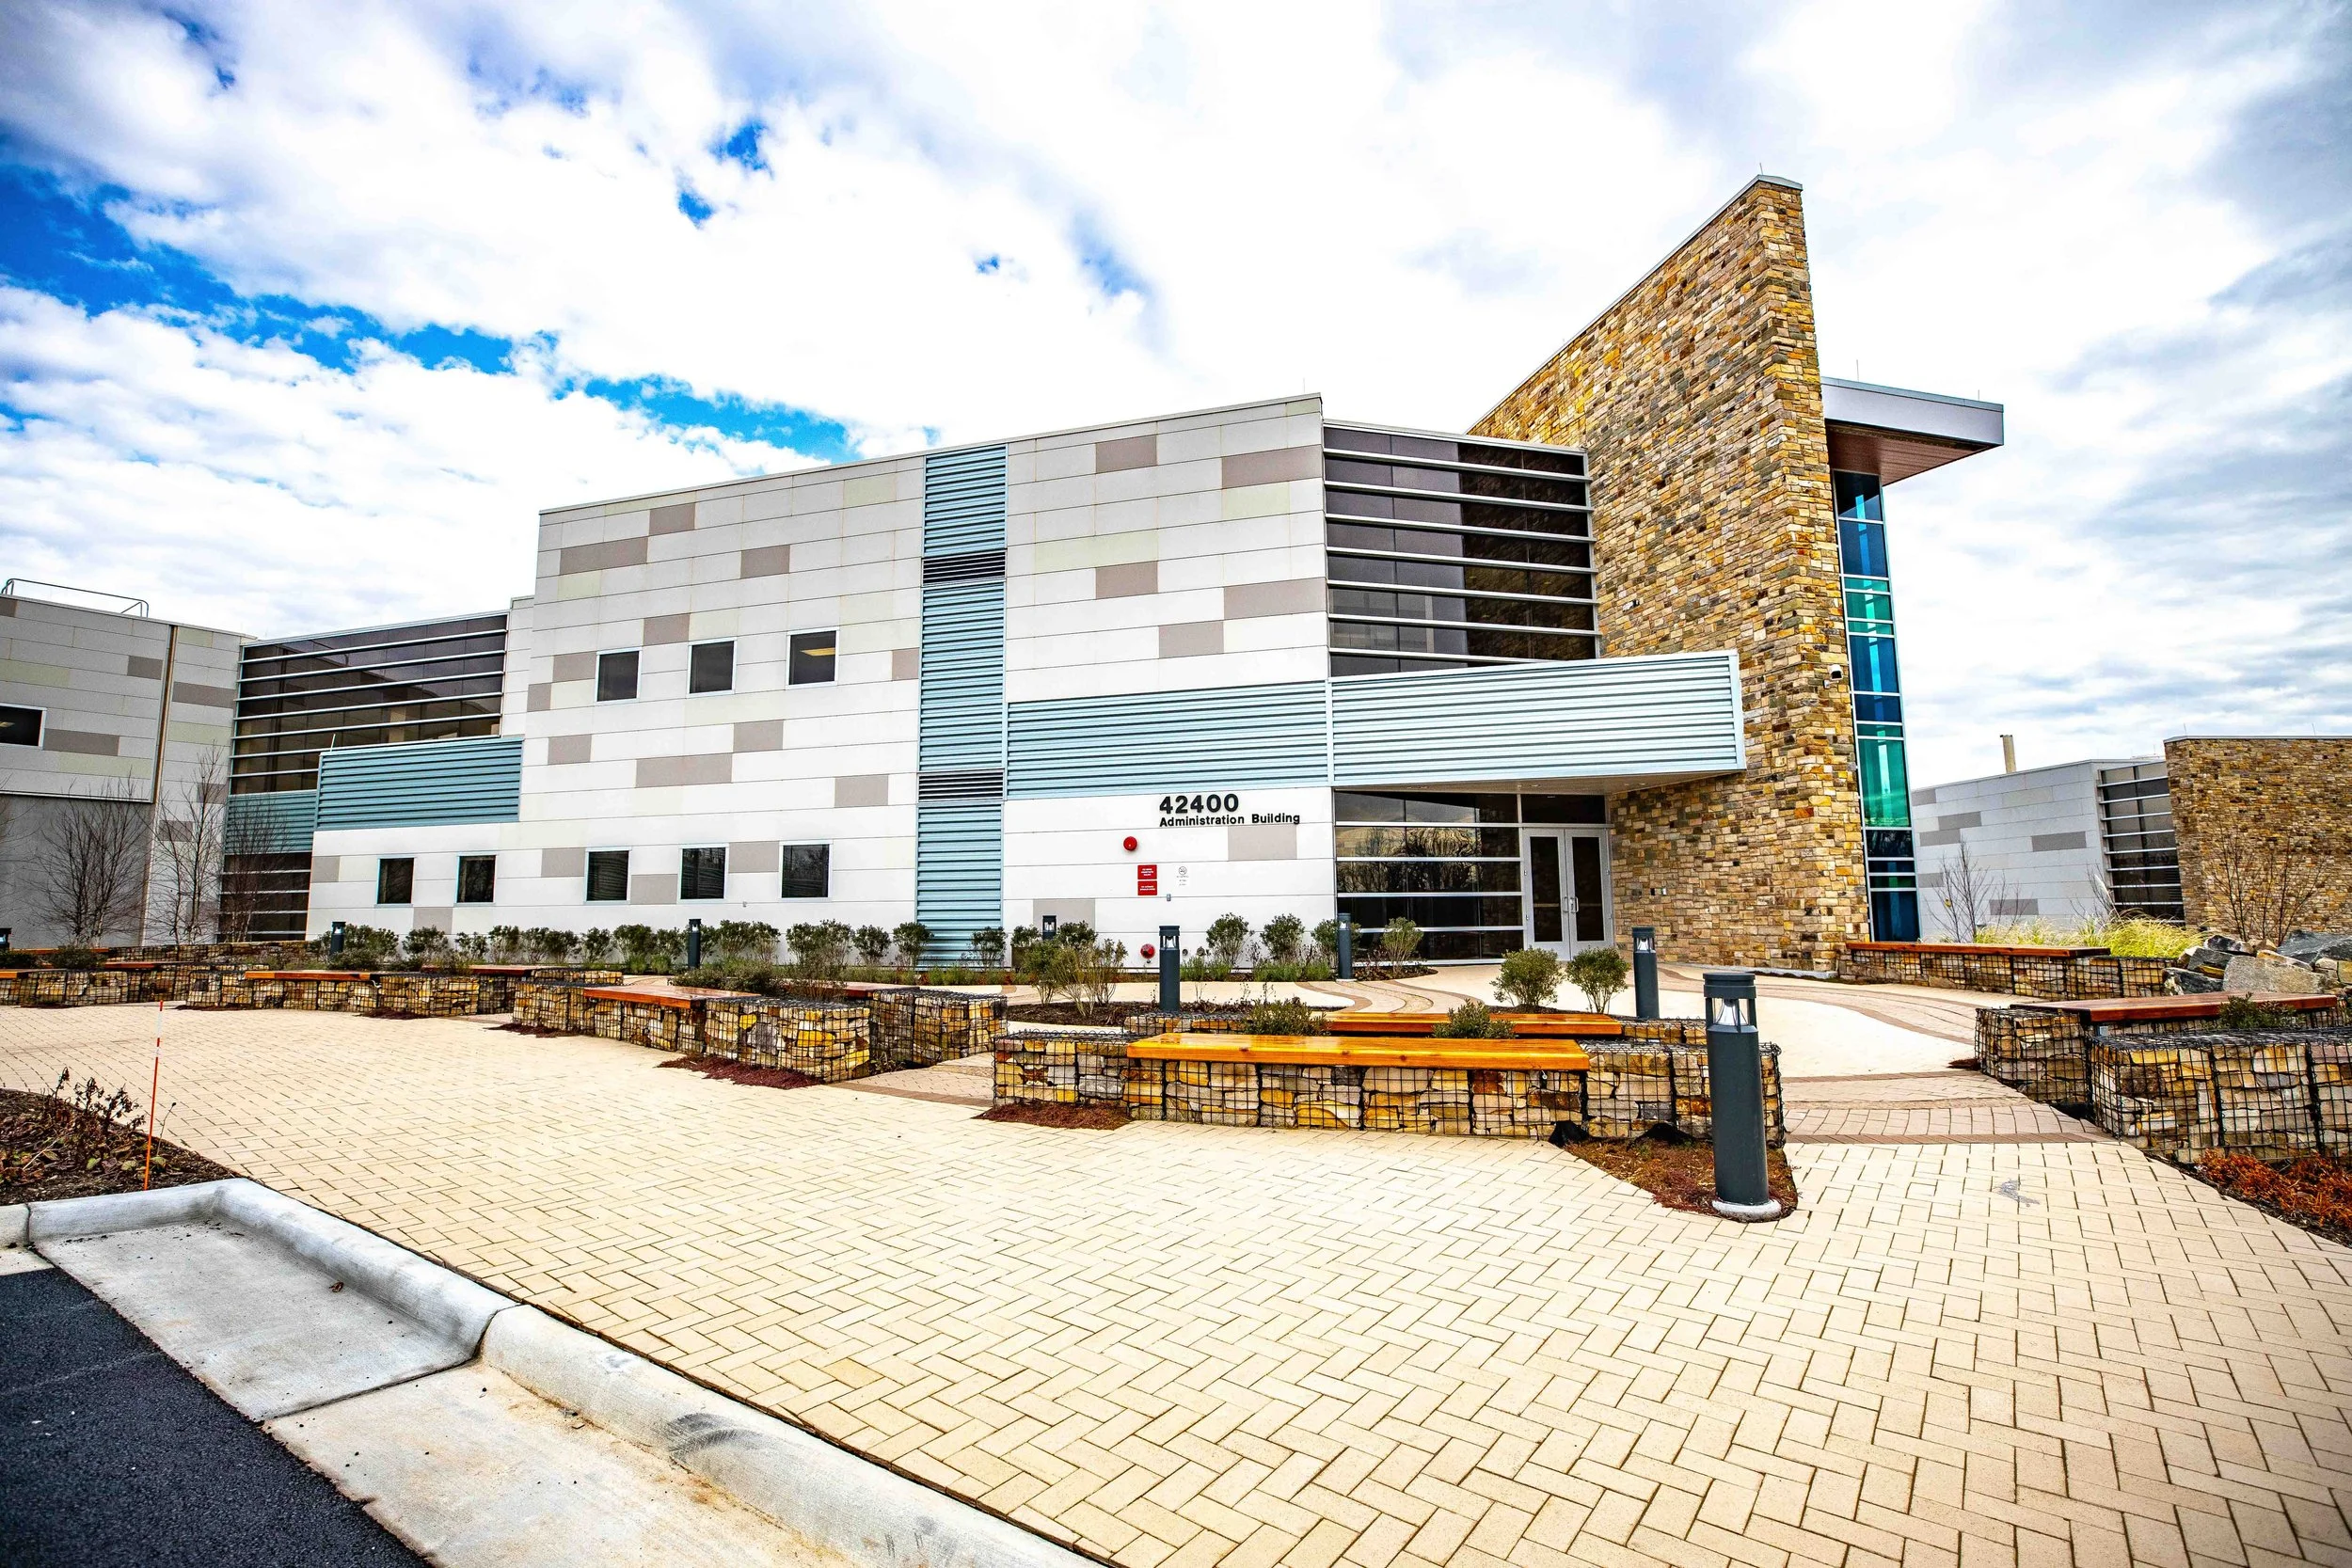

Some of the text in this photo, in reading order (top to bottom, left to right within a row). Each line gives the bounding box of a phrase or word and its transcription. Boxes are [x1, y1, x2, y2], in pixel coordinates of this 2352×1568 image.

[1159, 794, 1239, 814] 42400
[1159, 813, 1300, 827] Administration Building
